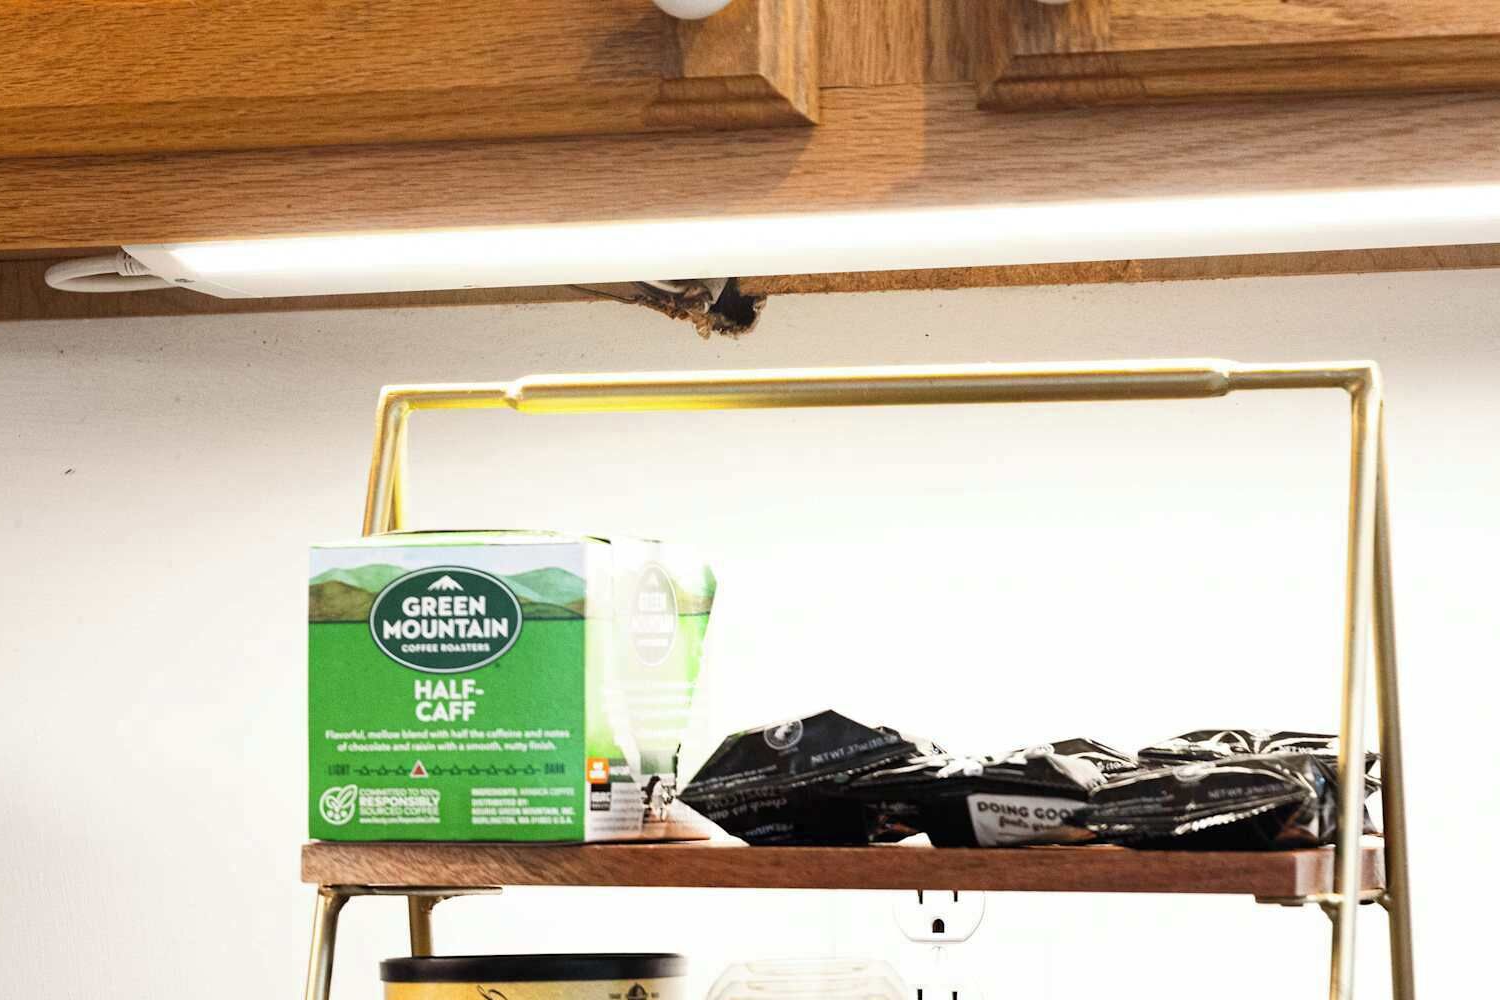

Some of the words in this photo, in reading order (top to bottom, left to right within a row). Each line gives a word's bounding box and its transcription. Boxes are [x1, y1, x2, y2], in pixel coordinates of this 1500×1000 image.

[402, 595, 486, 617] GREEN
[383, 618, 508, 639] MOUNTAIN
[401, 643, 438, 653] COFFEE
[440, 642, 490, 652] ROASTERS
[414, 679, 485, 700] HALF-
[415, 701, 476, 722] CAFF
[977, 801, 1030, 817] DOING
[1034, 807, 1076, 821] GOO
